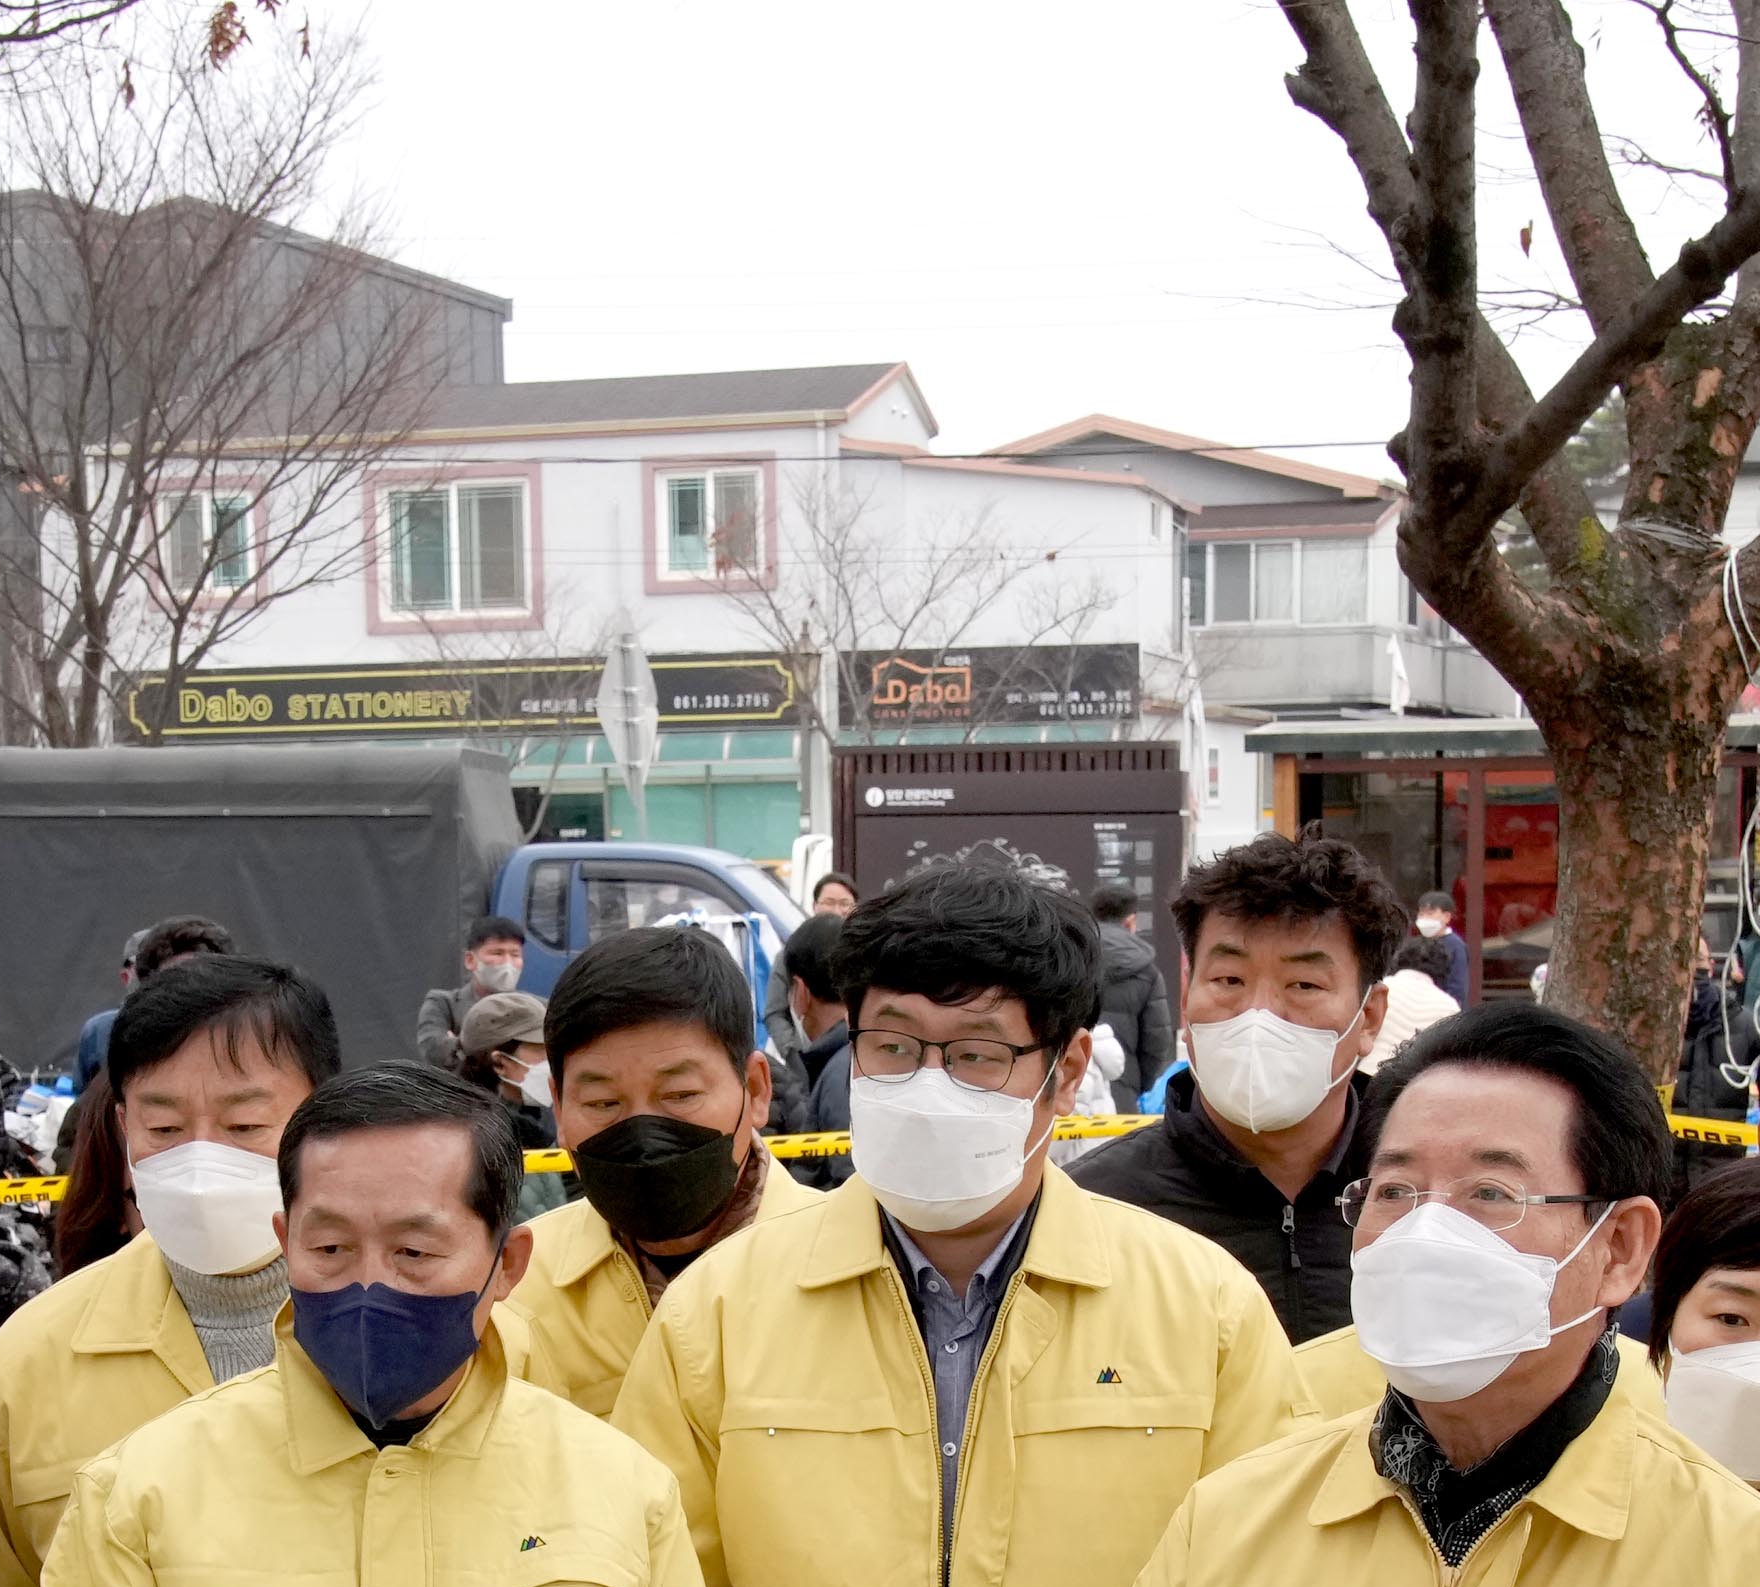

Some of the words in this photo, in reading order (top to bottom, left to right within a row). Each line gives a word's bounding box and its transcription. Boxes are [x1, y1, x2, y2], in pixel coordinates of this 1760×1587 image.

[179, 688, 273, 723] Dabo
[287, 689, 472, 722] STATIONERY
[887, 678, 962, 705] Dabo
